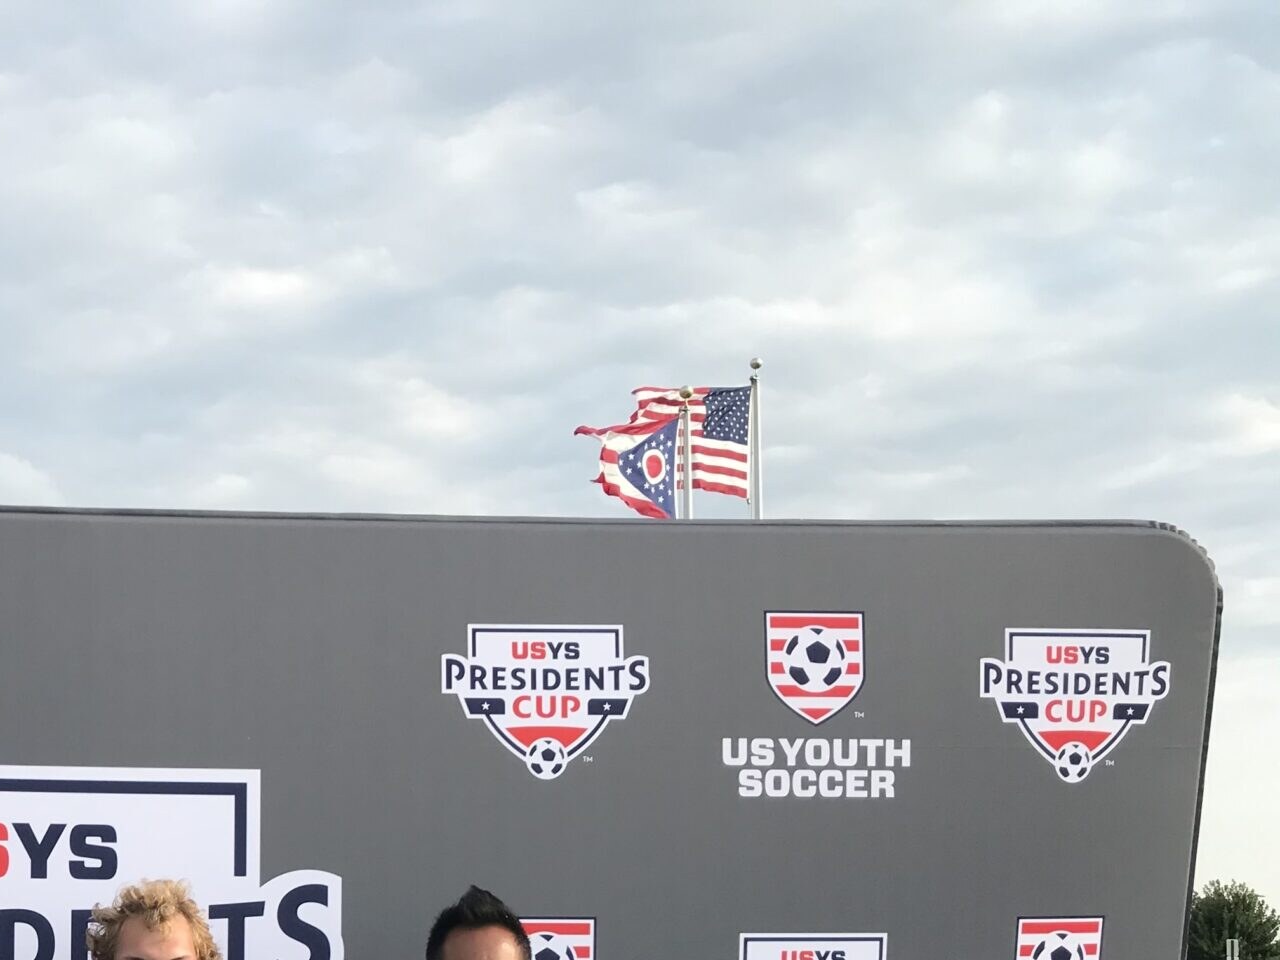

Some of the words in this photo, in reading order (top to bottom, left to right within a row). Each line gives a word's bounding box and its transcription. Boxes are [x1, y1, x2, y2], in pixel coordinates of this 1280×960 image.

[512, 642, 579, 659] USYS
[1047, 646, 1109, 664] USYS
[446, 659, 645, 690] PRESIDENTS
[984, 663, 1166, 695] PRESIDENTS
[513, 696, 580, 718] CUP
[1045, 700, 1107, 722] CUP
[739, 769, 894, 797] SOCCER
